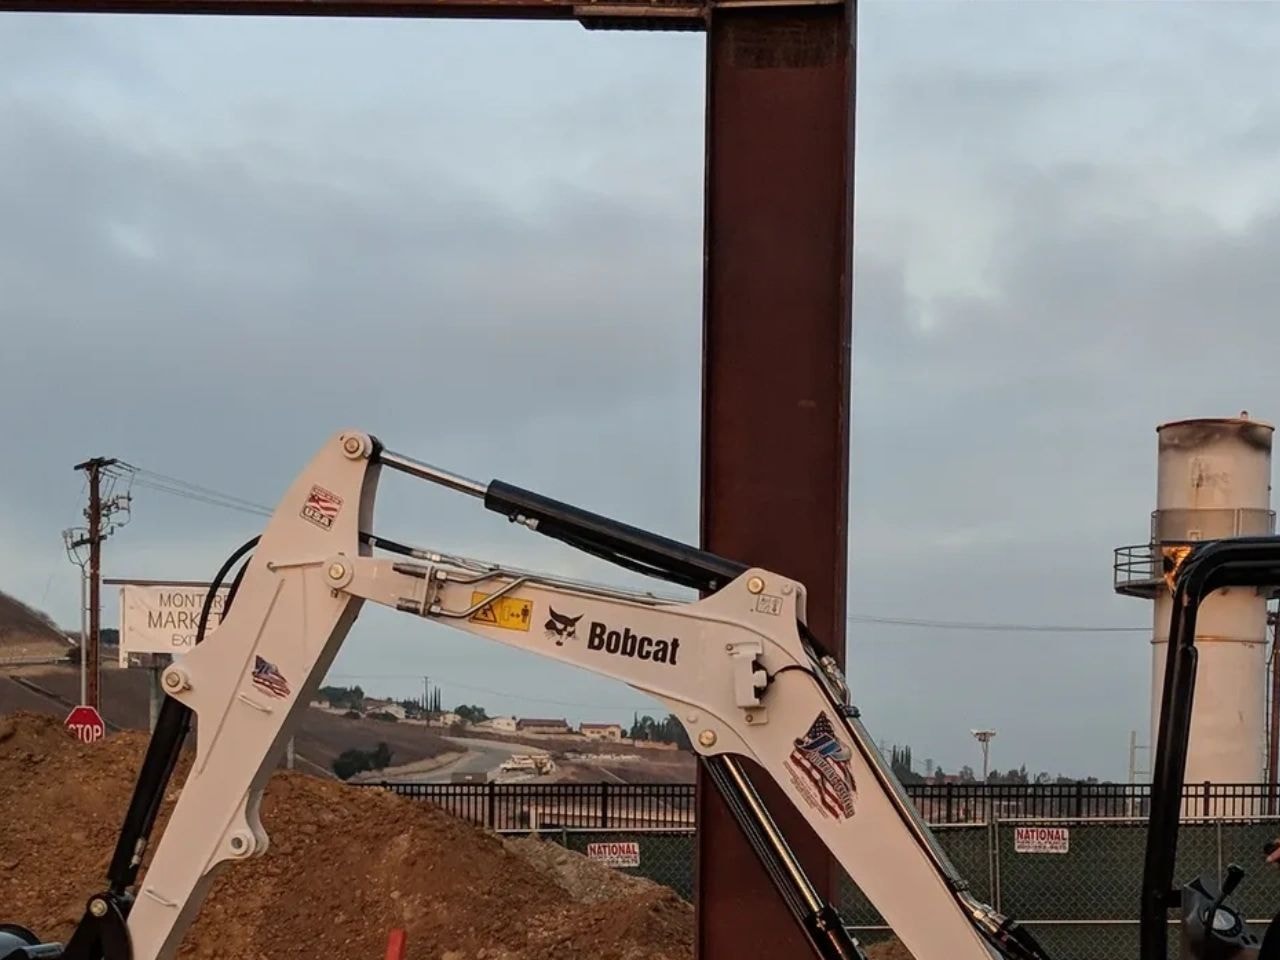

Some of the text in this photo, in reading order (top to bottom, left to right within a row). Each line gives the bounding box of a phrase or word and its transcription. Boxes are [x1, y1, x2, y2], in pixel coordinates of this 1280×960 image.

[587, 621, 680, 666] Bobcat
[1016, 829, 1067, 841] NATIONAL
[590, 844, 637, 856] NATIONAL
